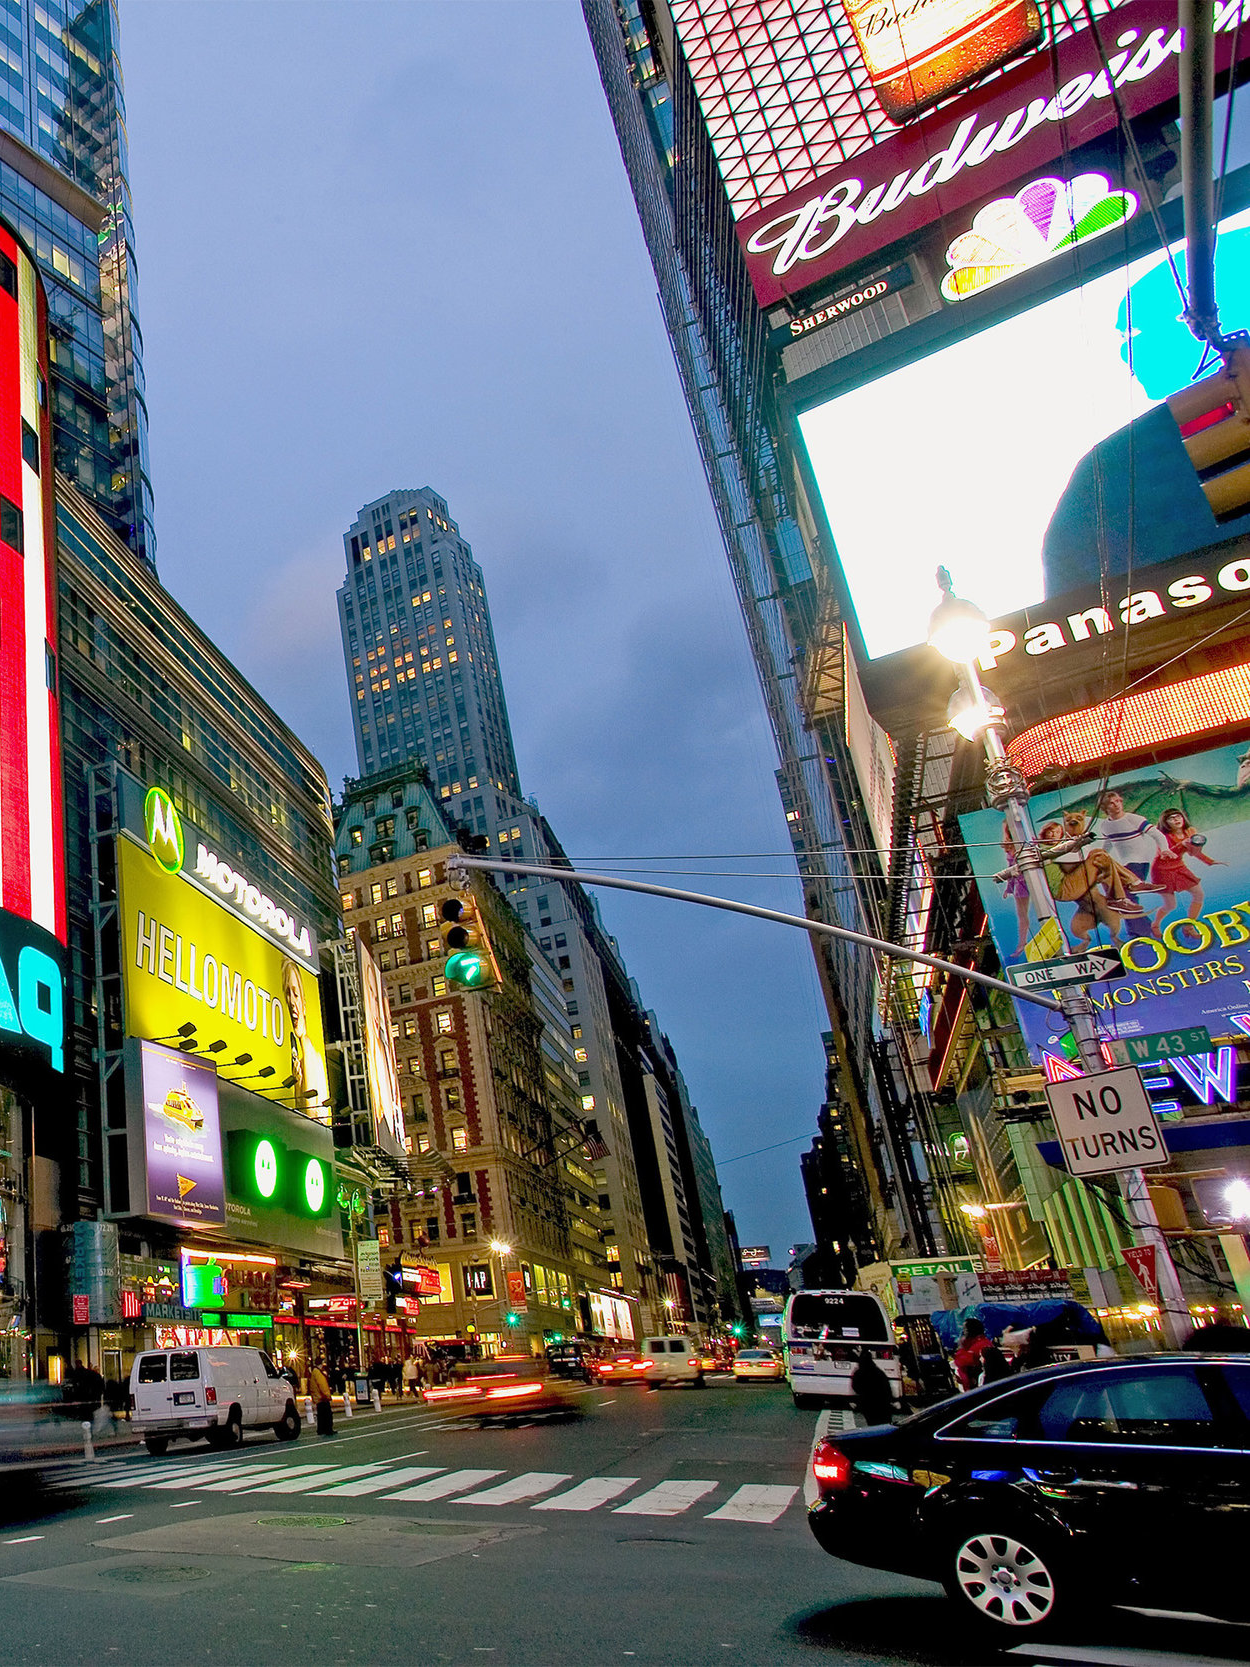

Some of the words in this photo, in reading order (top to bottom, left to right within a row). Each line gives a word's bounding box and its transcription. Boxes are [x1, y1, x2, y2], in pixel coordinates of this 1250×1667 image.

[194, 842, 312, 957] MOTOROLA
[136, 910, 283, 1047] HELLOMOTO
[1024, 967, 1056, 984] ONE
[1074, 959, 1109, 975] WAY
[1052, 955, 1245, 1012] MONSTERS
[1130, 1040, 1150, 1058] W
[1156, 1035, 1186, 1055] 43
[1190, 1030, 1207, 1042] ST
[1071, 1085, 1122, 1120] NO
[1064, 1125, 1157, 1161] TURNS
[897, 1263, 968, 1276] RETAIL
